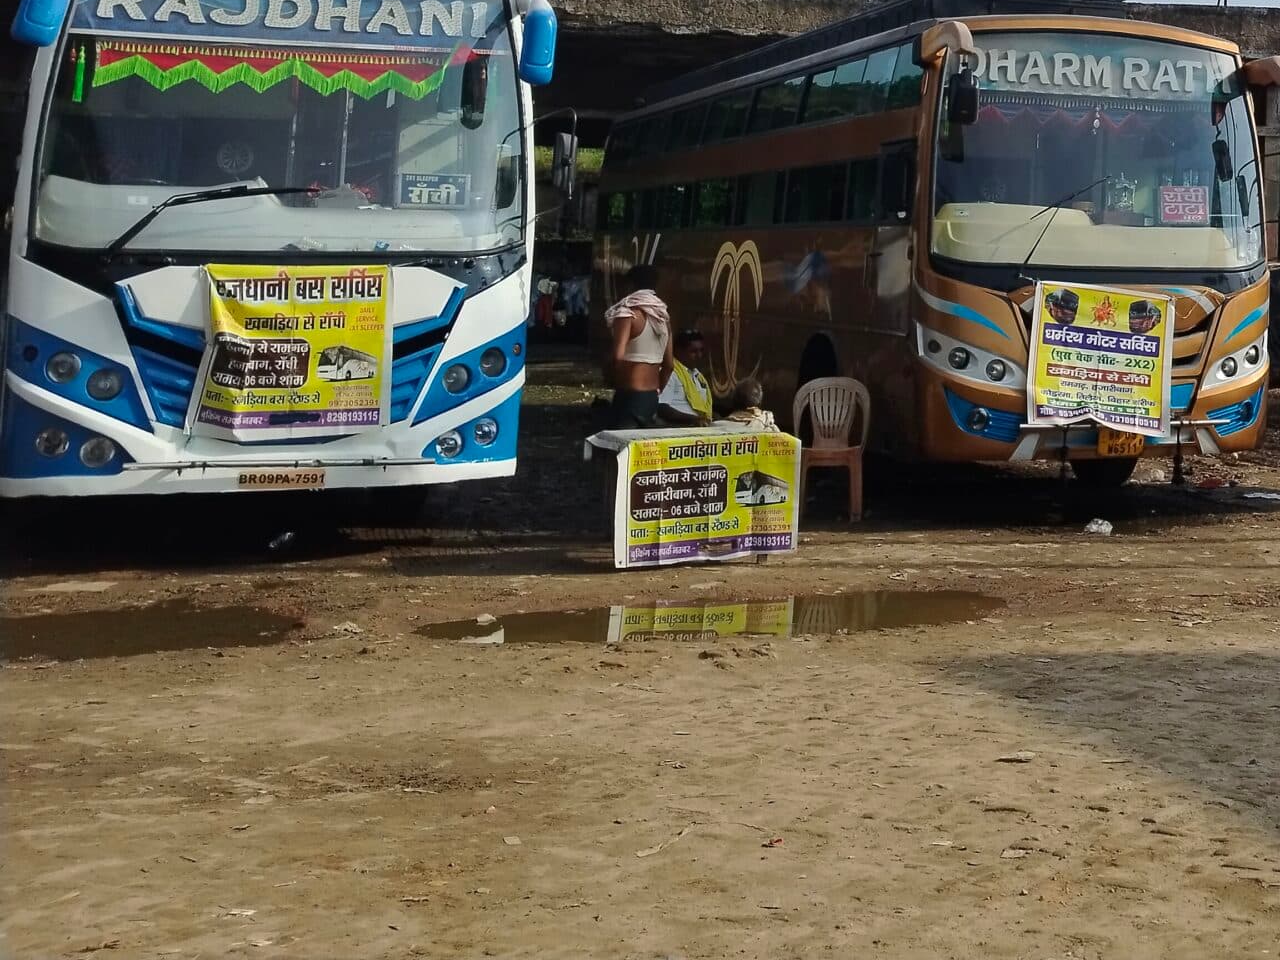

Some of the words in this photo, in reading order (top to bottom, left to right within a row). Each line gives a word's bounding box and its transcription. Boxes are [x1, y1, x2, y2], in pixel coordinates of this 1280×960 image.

[1122, 56, 1231, 94] RATH
[1163, 202, 1205, 215] टाटा
[295, 276, 326, 300] बस
[331, 268, 384, 299] सर्विस
[303, 311, 315, 330] से
[1045, 326, 1083, 341] धर्मरथ
[1086, 331, 1118, 348] मोटर
[1119, 336, 1158, 353] सर्विस
[1047, 366, 1103, 380] खगड़िया
[1105, 371, 1121, 381] से
[668, 441, 718, 462] खगड़िया
[721, 438, 732, 457] से
[636, 472, 679, 489] खगड़िया
[681, 469, 691, 483] से
